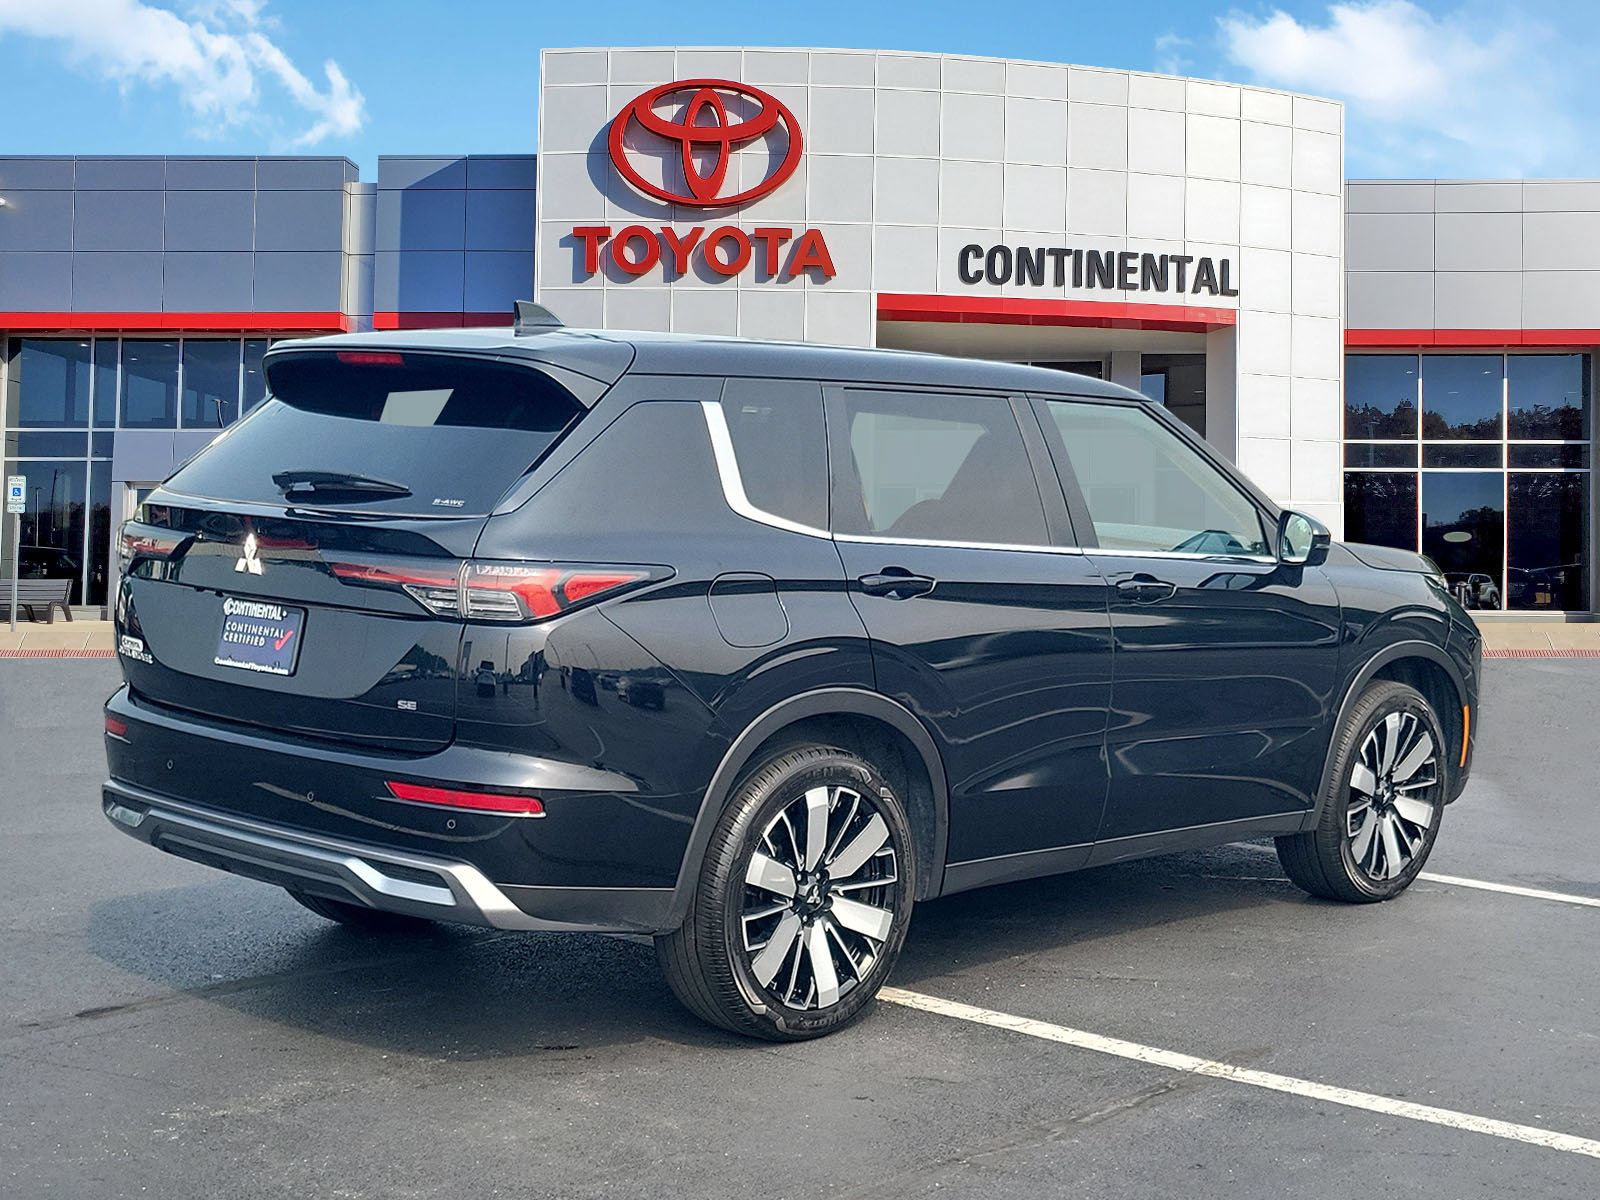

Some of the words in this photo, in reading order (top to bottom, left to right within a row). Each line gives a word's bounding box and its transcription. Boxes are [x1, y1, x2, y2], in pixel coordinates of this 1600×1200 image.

[573, 225, 836, 276] TOYOTA
[958, 244, 1239, 297] CONTINENTAL
[223, 598, 282, 621] CONTINENTAL
[223, 632, 265, 647] CERTIFIED
[225, 621, 284, 639] CONTINENTAL
[397, 700, 417, 710] SE
